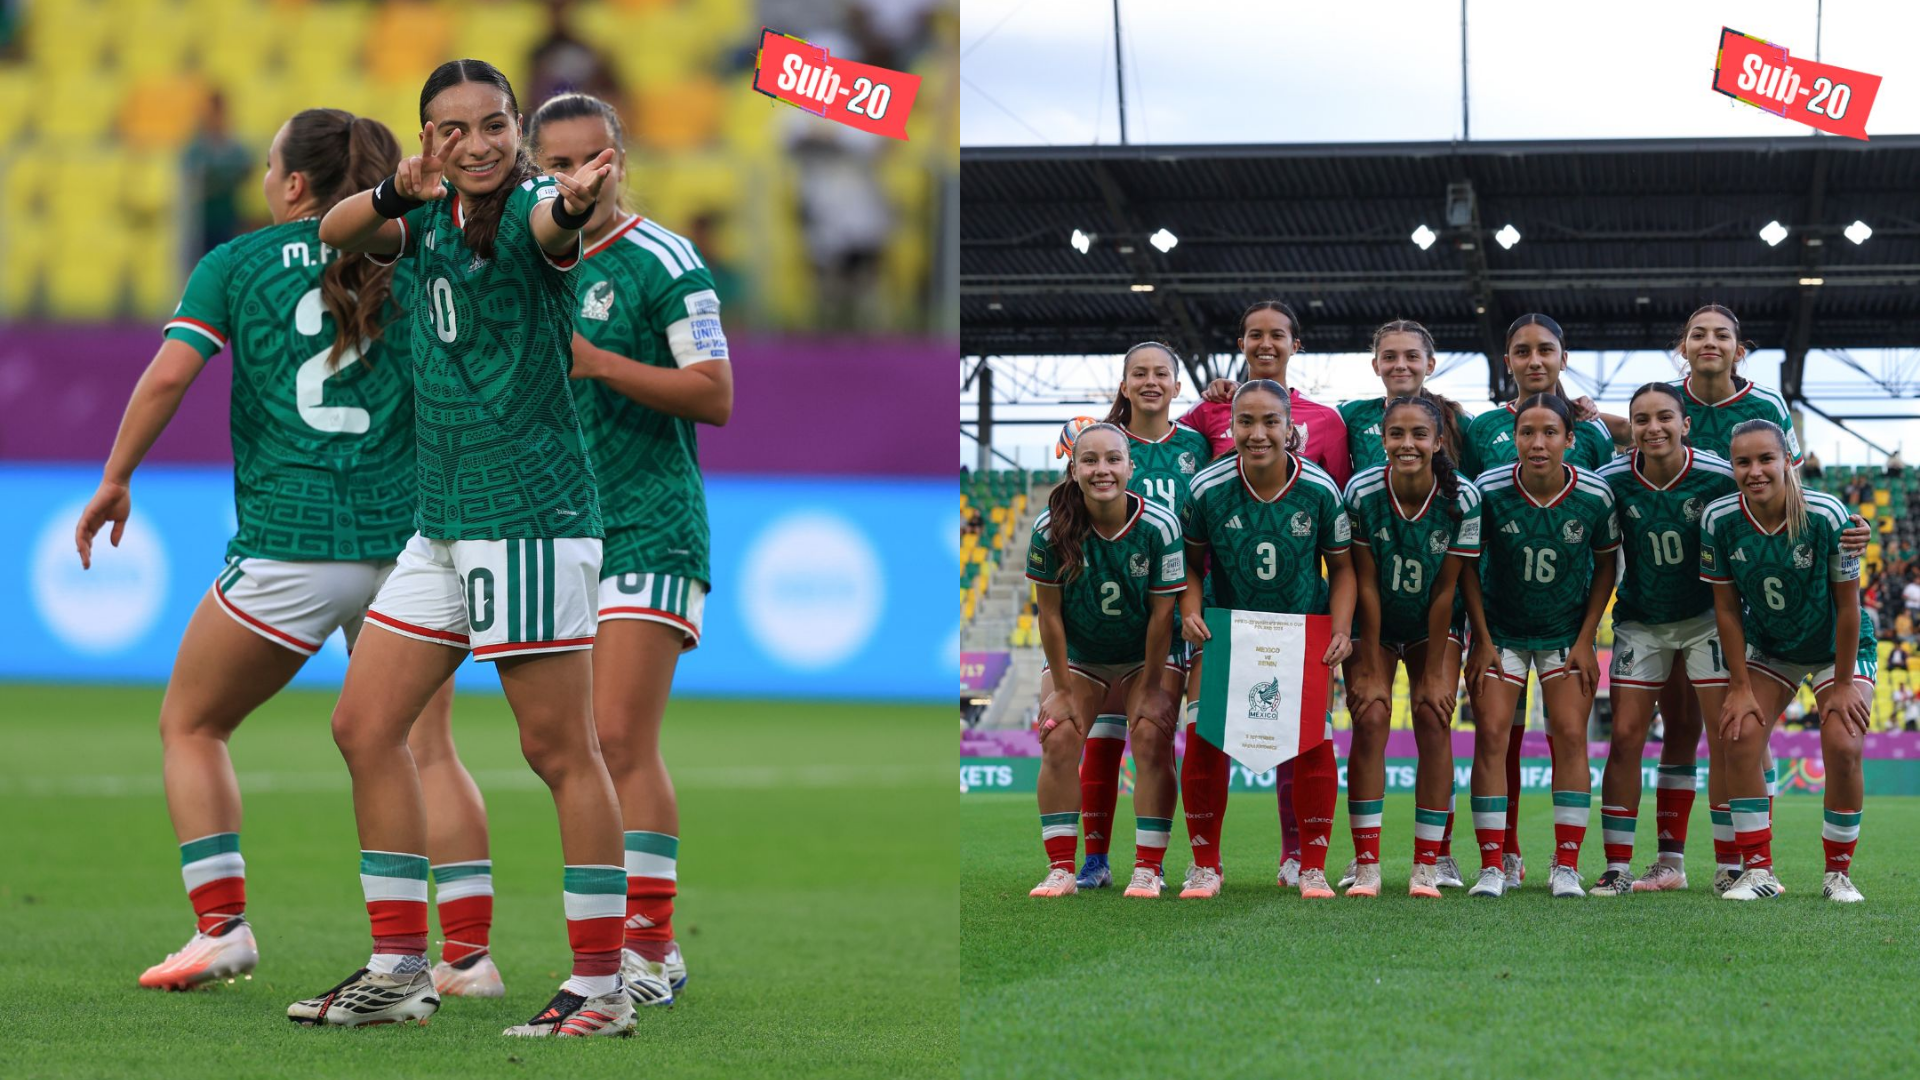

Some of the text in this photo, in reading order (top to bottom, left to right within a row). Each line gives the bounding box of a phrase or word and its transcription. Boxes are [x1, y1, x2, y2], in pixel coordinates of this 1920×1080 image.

[295, 286, 371, 434] 2
[1143, 478, 1175, 512] 14
[1257, 542, 1277, 580] 3
[1523, 546, 1557, 583] 16
[1648, 530, 1684, 566] 10
[1392, 554, 1422, 593] 13
[459, 567, 494, 632] 0
[1101, 581, 1122, 616] 2
[1763, 576, 1786, 610] 6
